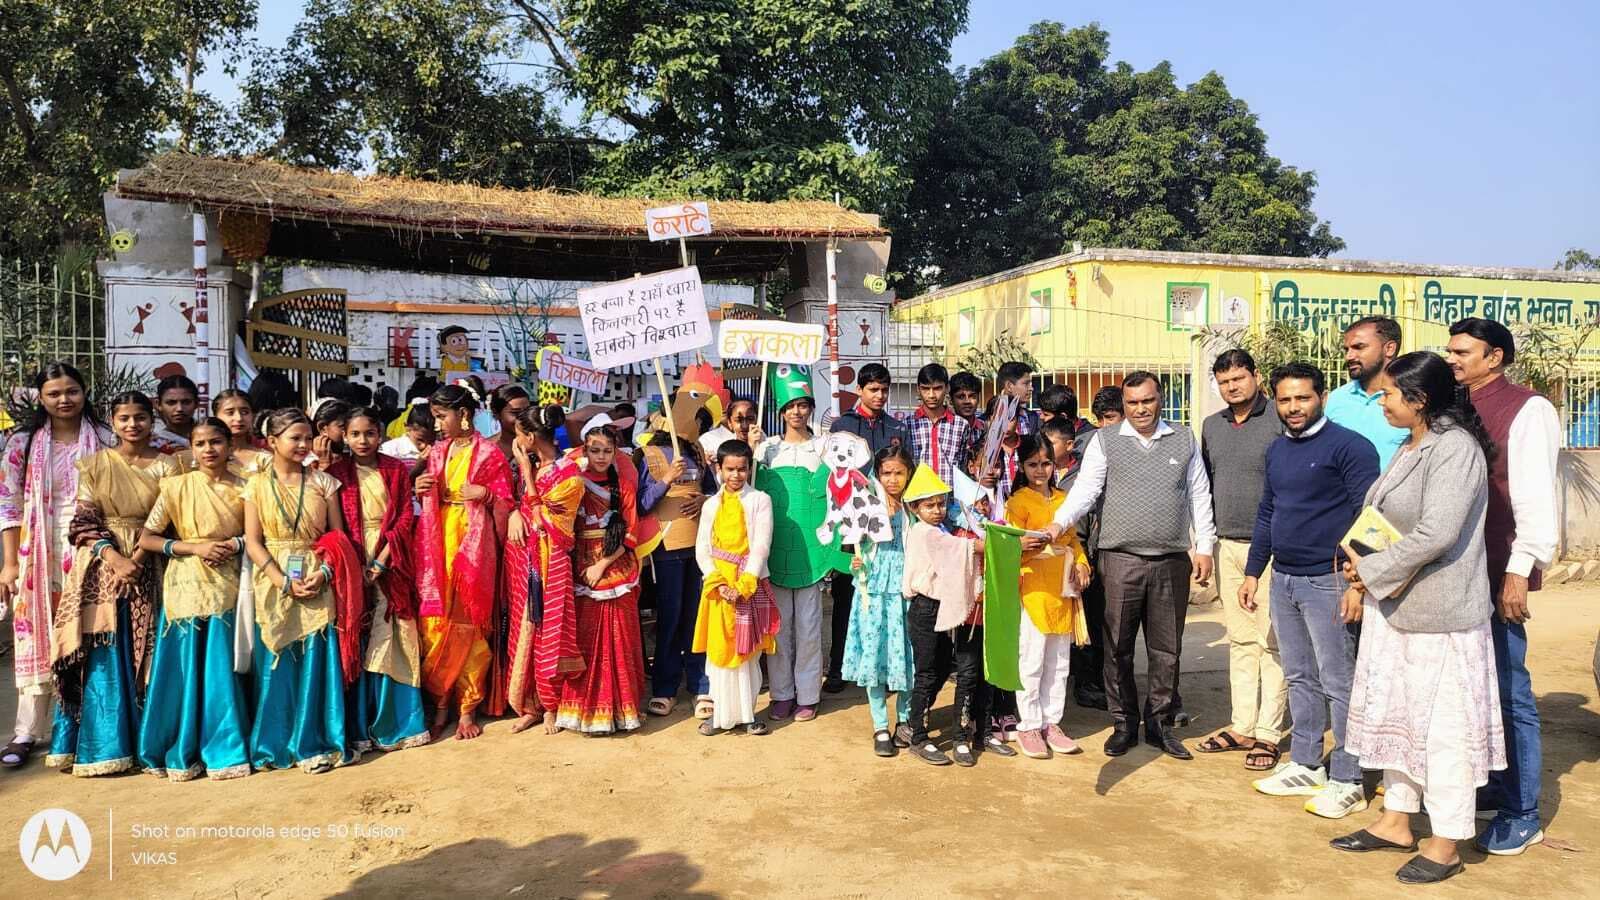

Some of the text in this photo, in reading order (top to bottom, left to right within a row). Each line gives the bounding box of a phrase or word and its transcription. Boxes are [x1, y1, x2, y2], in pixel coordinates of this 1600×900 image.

[652, 205, 707, 234] कराटे
[585, 301, 596, 314] हर
[601, 296, 623, 310] बच्चा
[628, 289, 636, 305] है
[592, 299, 686, 334] किलकारी पर है
[1423, 280, 1479, 326] बिहार
[1482, 296, 1522, 326] बाल
[594, 331, 639, 356] सबको
[641, 321, 696, 344] विश्वास
[724, 330, 822, 360] हस्तकला
[546, 352, 608, 392] चित्रकला
